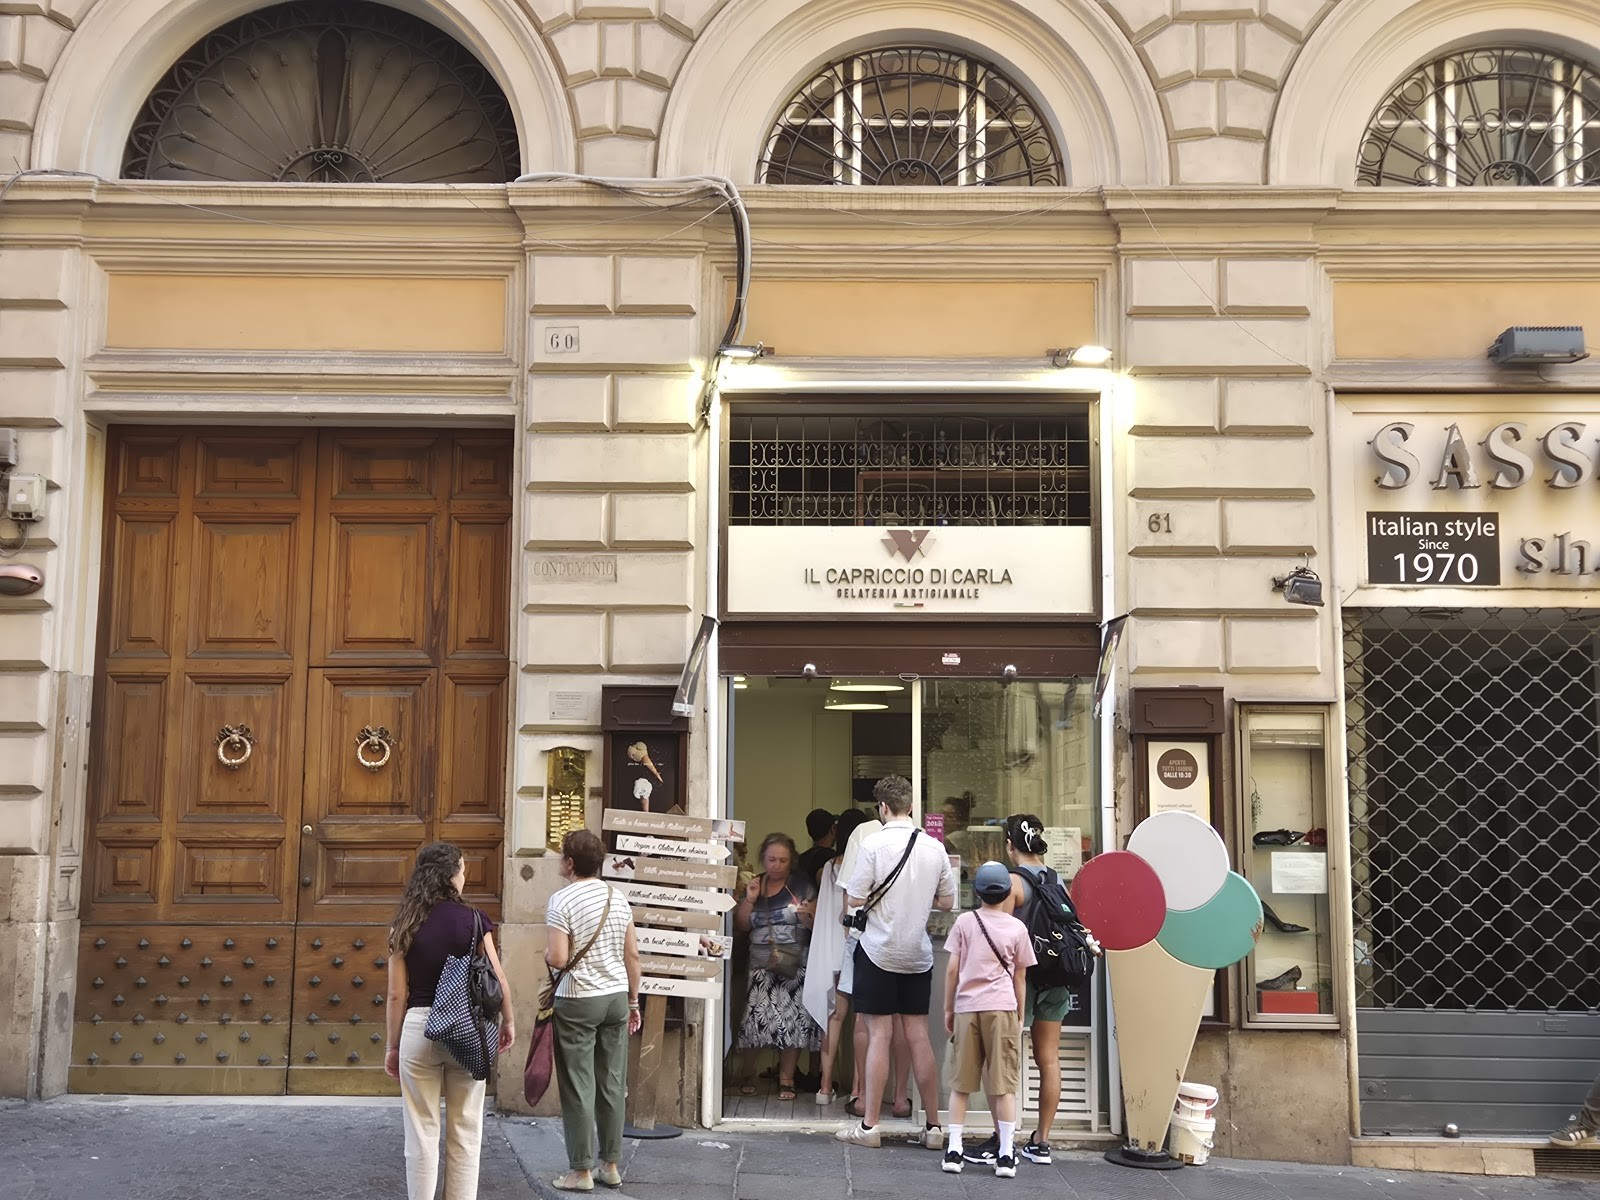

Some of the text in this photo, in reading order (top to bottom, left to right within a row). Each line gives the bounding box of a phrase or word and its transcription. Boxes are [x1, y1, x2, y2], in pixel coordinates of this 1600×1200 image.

[550, 333, 573, 349] 60
[1371, 421, 1600, 491] SASS
[1148, 512, 1172, 534] 61
[1372, 516, 1496, 541] Italian style
[1418, 538, 1450, 550] Since
[1519, 531, 1600, 576] sh
[533, 560, 614, 576] CONDOMINIO
[1393, 552, 1479, 583] 1970
[804, 567, 1013, 584] IL CAPRICCIO DI CARLA
[836, 587, 979, 599] GELATERIA ARTIGIANALE
[633, 818, 649, 828] home
[649, 821, 666, 829] made
[634, 841, 650, 850] Vegan
[688, 846, 708, 856] choices
[643, 866, 717, 880] With premium ingredients
[628, 890, 704, 905] Without artificial additives
[651, 937, 666, 945] best
[665, 939, 690, 948] qualities
[668, 961, 686, 972] food
